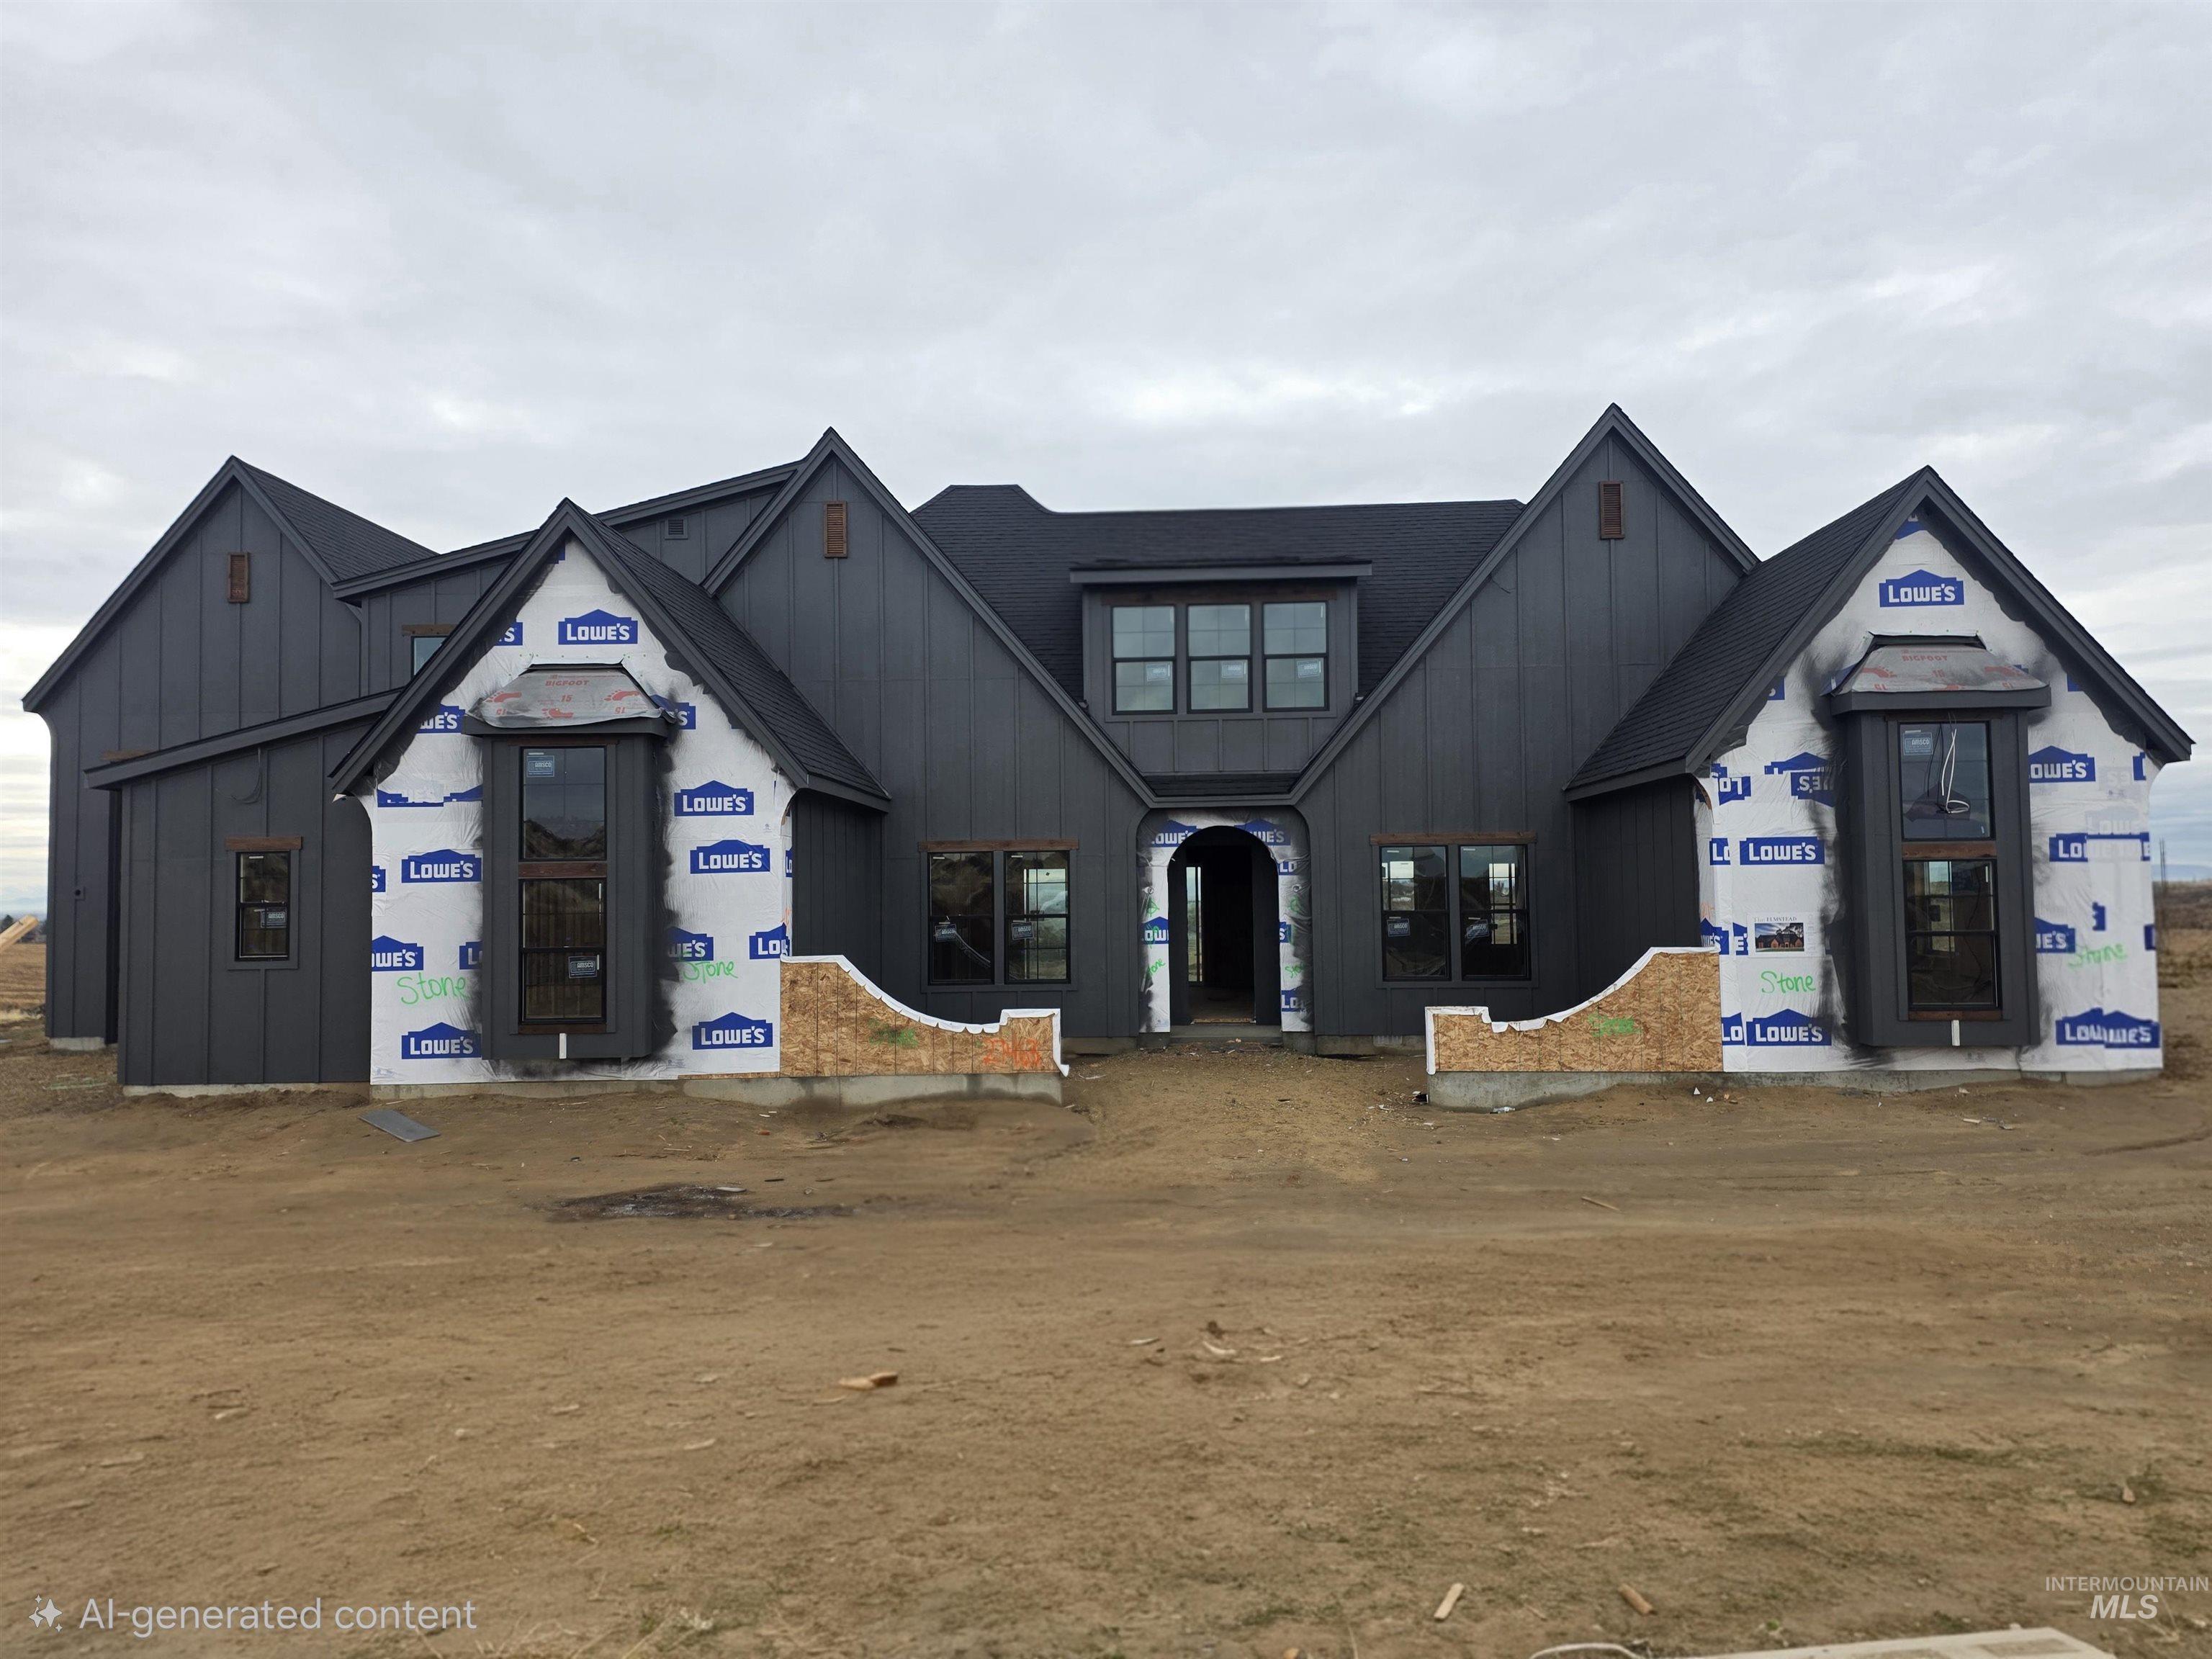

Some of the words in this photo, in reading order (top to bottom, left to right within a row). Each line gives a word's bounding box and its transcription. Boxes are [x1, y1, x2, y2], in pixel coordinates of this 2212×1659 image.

[1888, 583, 1956, 603] LOWE'S
[566, 623, 630, 641] LOWE'S
[683, 793, 746, 812] LOWE'S
[698, 850, 763, 869] LOWE'S
[1748, 842, 1817, 861] LOWE'S
[410, 860, 474, 879] LOWE'S
[397, 972, 470, 1004] Stone
[1761, 971, 1816, 994] Stone
[701, 1026, 765, 1045] LOWE'S
[1755, 1023, 1823, 1043] LOWE'S
[410, 1037, 474, 1055] LOWE'S
